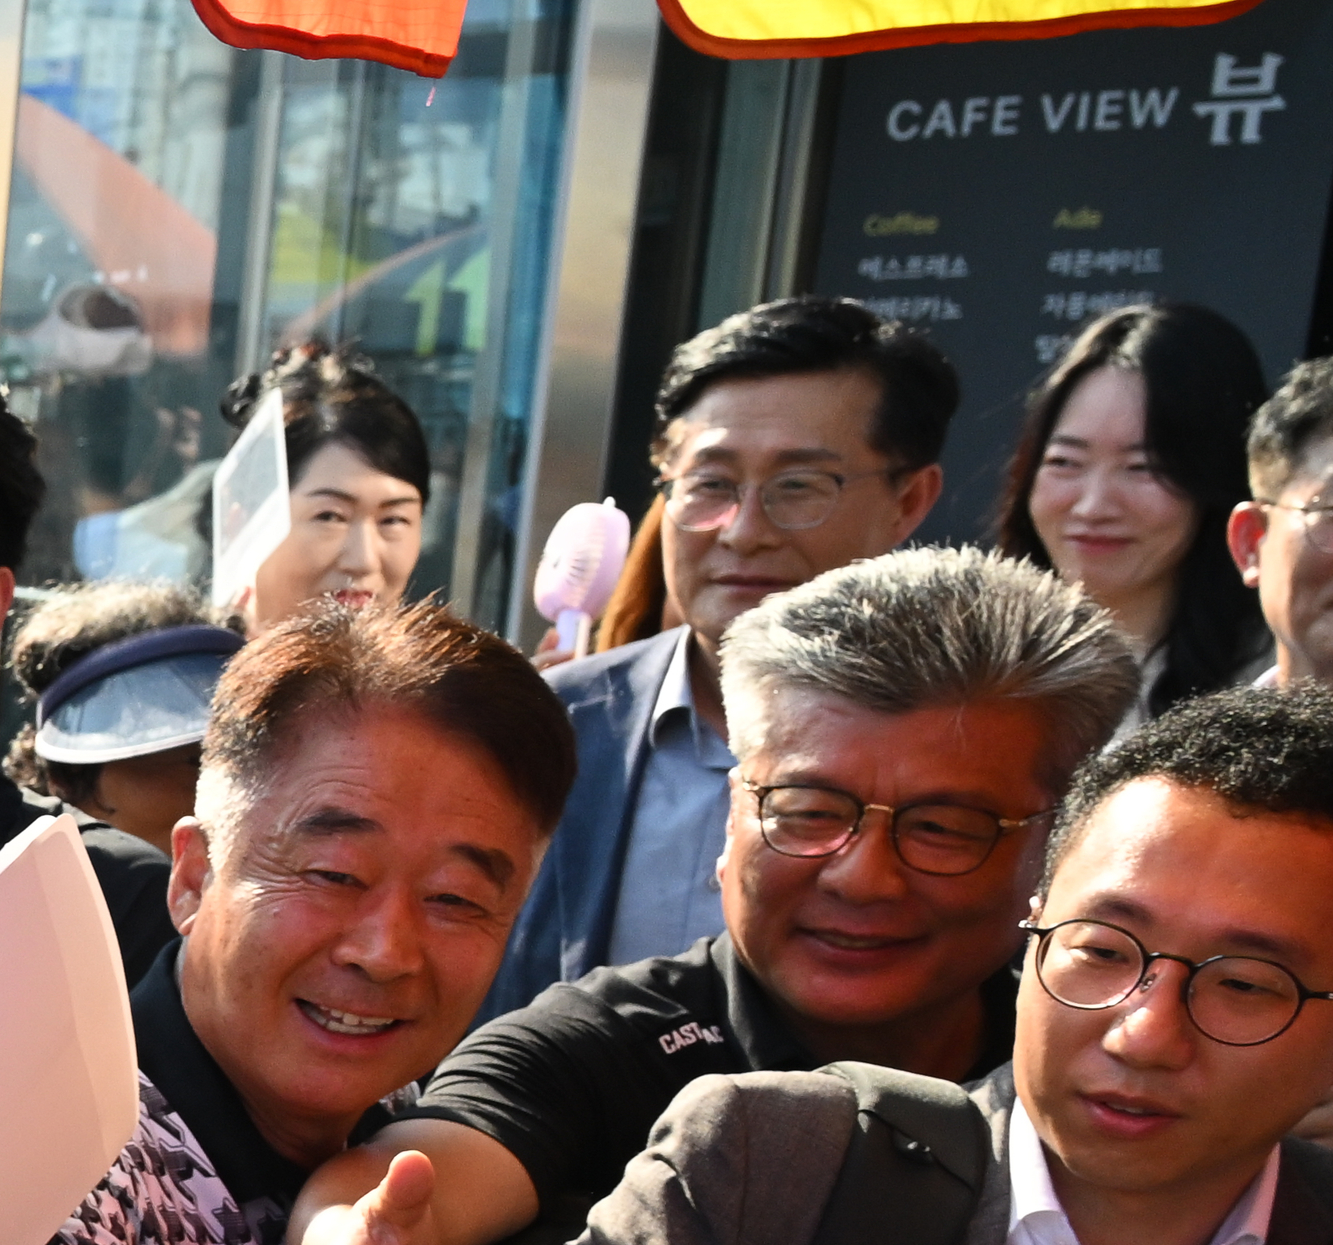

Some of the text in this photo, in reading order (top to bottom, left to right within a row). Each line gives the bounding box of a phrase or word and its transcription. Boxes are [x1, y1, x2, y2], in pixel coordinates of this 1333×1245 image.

[887, 87, 1180, 141] CAFE VIEW
[1192, 52, 1286, 146] 뷰
[863, 212, 939, 236] Coffee
[857, 254, 969, 281] 에스프레소
